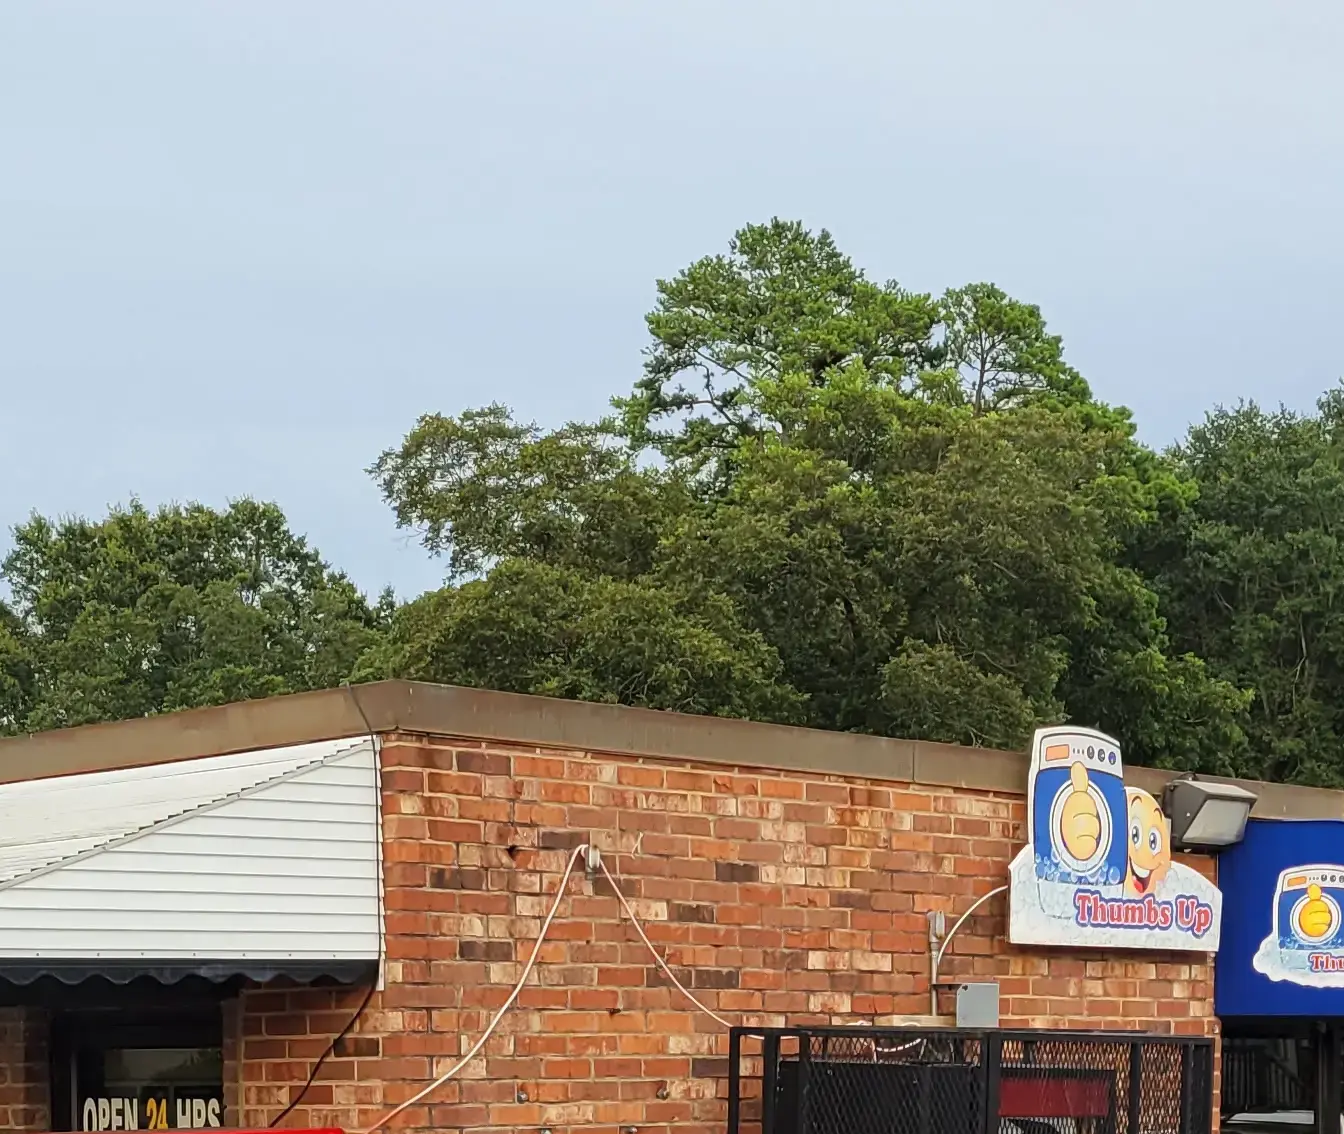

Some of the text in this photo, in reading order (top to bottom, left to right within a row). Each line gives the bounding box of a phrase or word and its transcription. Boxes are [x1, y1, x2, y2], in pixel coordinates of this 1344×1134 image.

[1075, 889, 1213, 938] Thumbs Up
[83, 1097, 220, 1132] OPEN 24 HRS
